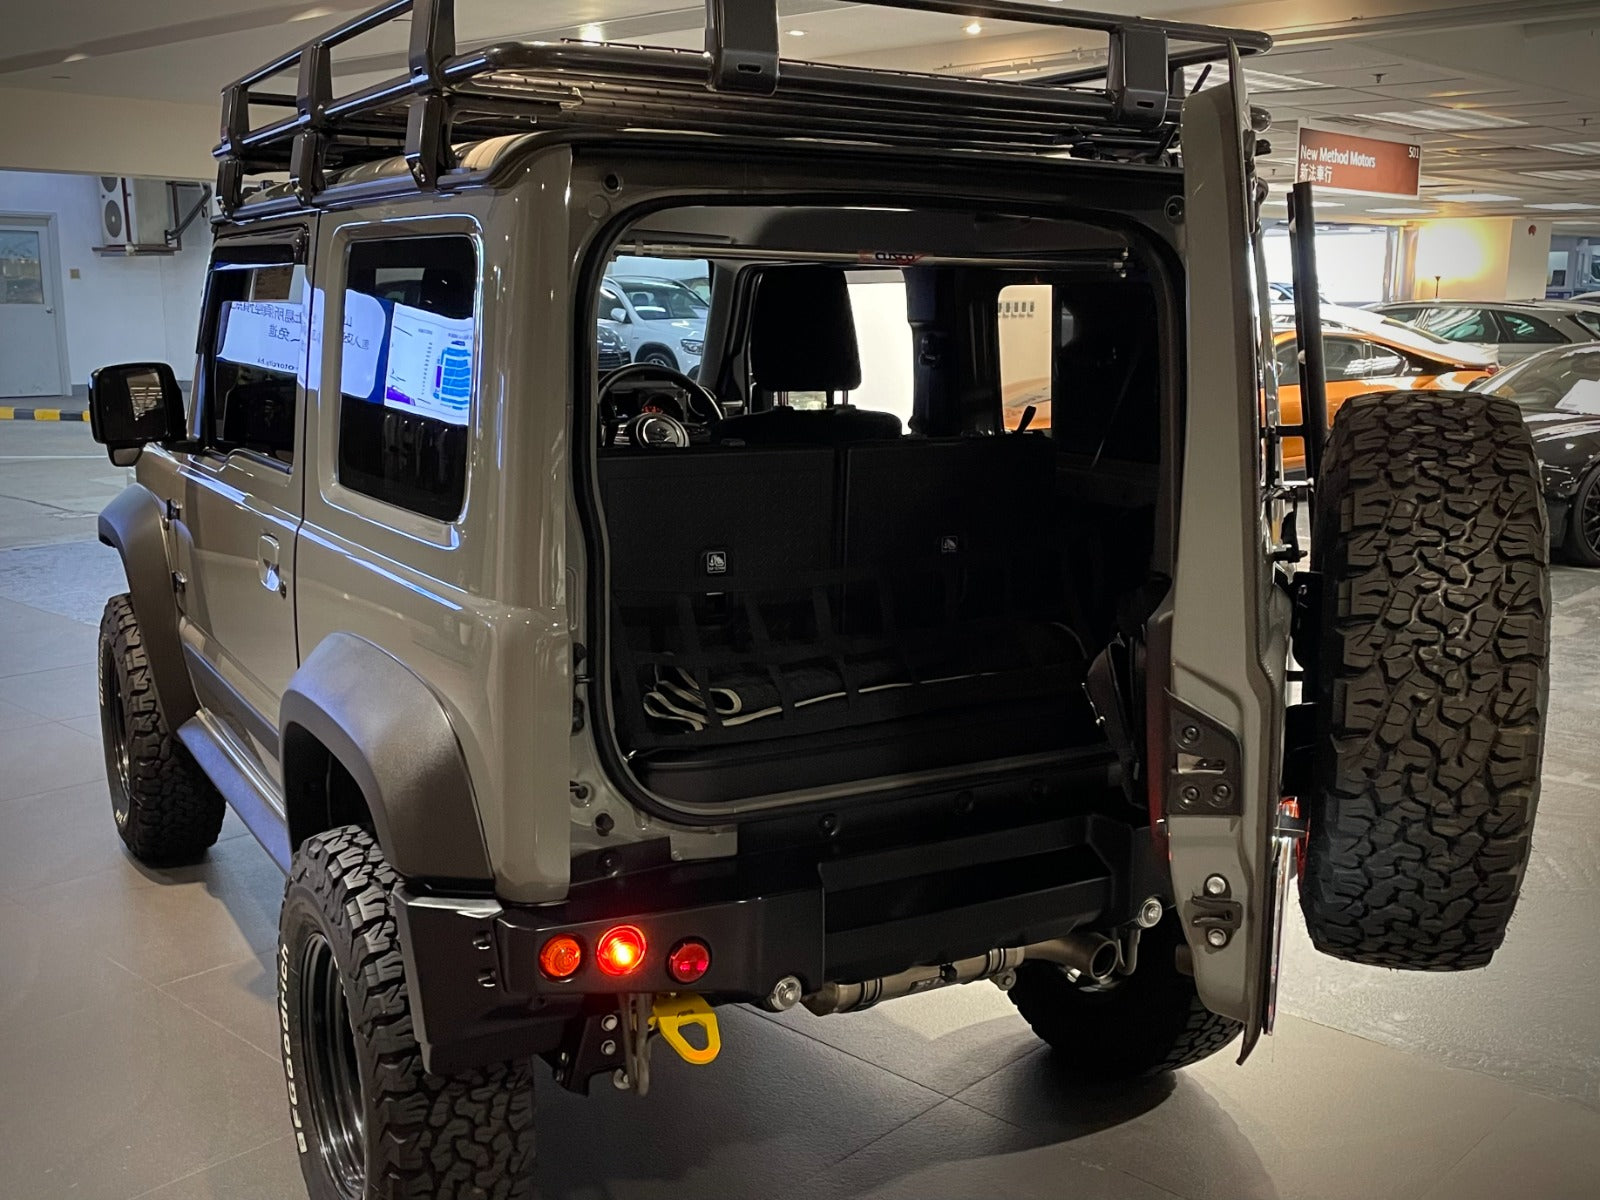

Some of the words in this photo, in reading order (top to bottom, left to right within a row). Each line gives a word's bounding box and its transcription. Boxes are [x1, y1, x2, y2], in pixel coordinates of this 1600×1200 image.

[1300, 144, 1318, 160] New
[1319, 147, 1349, 165] Method
[1350, 151, 1376, 168] Motors
[1299, 163, 1333, 183] 新法車行
[281, 943, 308, 1154] BFGoodrich
